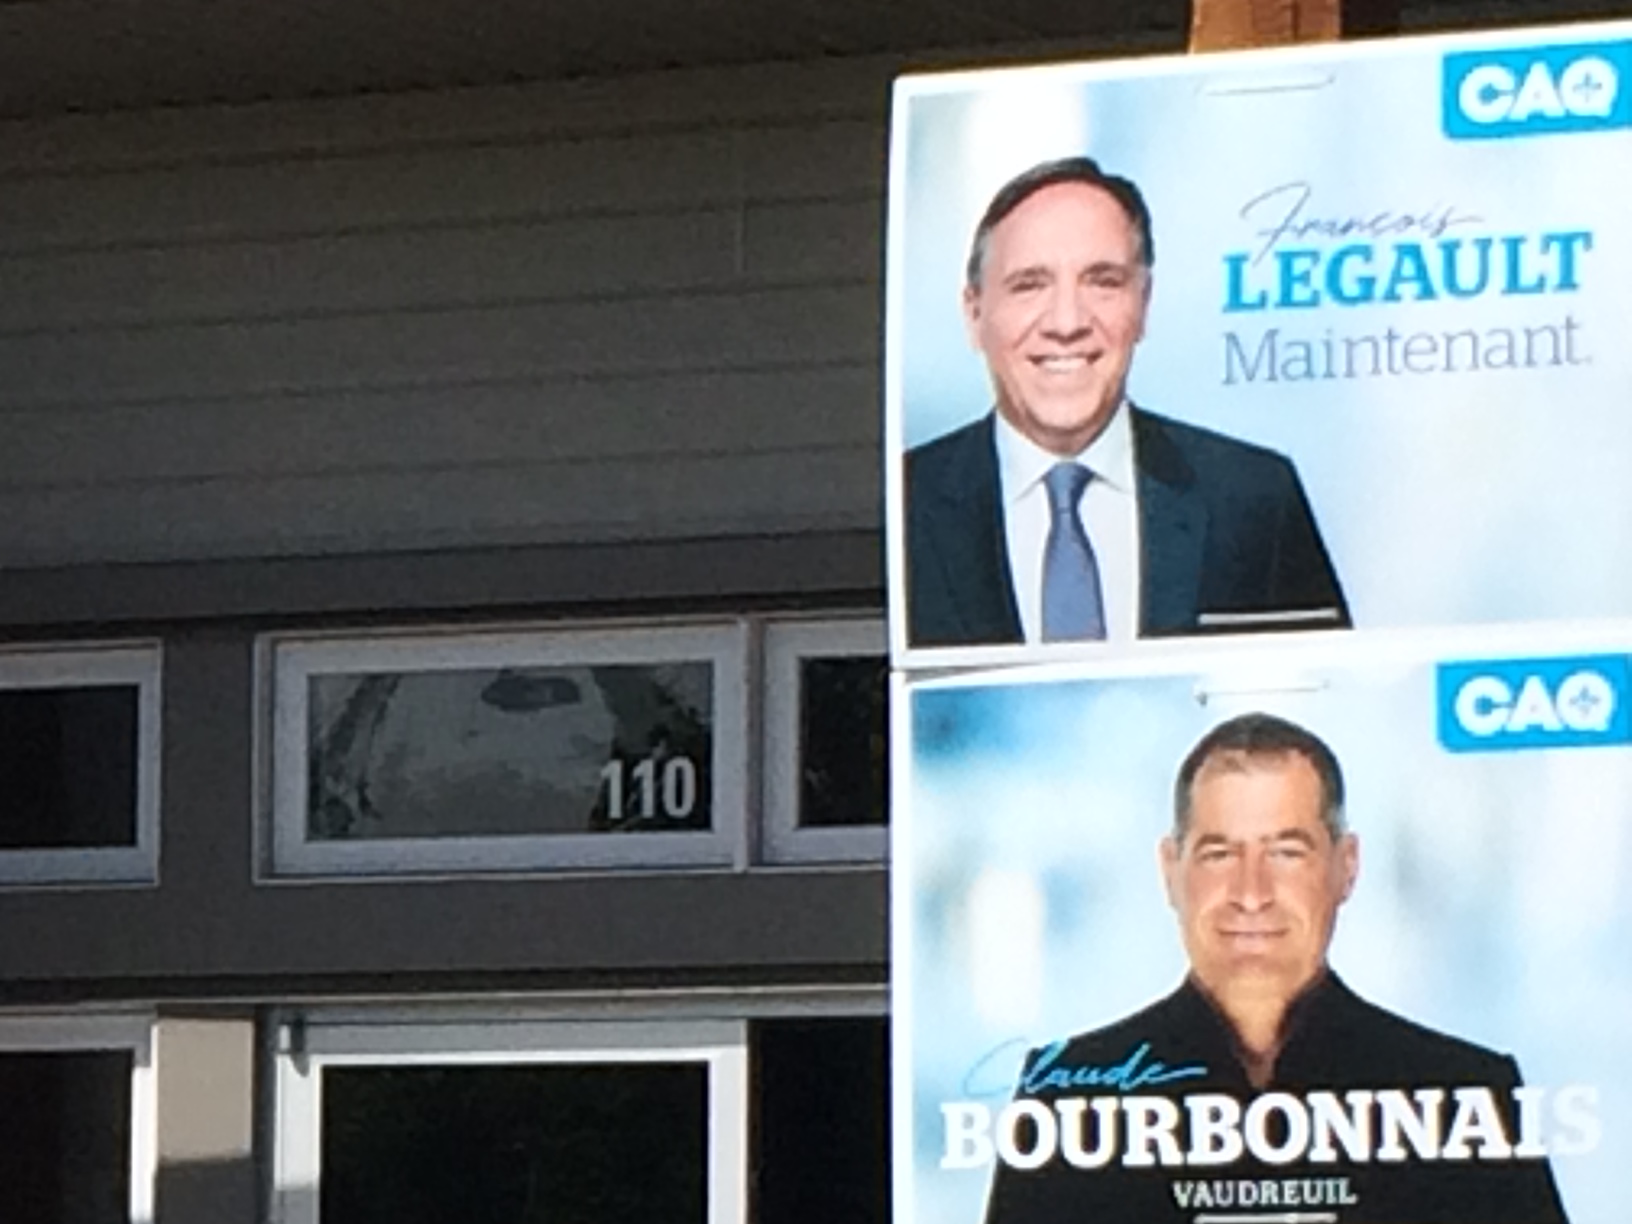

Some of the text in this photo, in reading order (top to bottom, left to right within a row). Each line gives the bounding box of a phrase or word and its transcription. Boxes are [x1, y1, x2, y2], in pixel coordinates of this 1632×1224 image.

[1458, 57, 1618, 124] CAQ
[1221, 231, 1596, 314] LEGAULT
[1454, 669, 1616, 735] CAQ
[600, 757, 696, 819] 110
[939, 1085, 1602, 1170] BOURBONNAIS
[1173, 1180, 1356, 1209] VAUDREUIL
